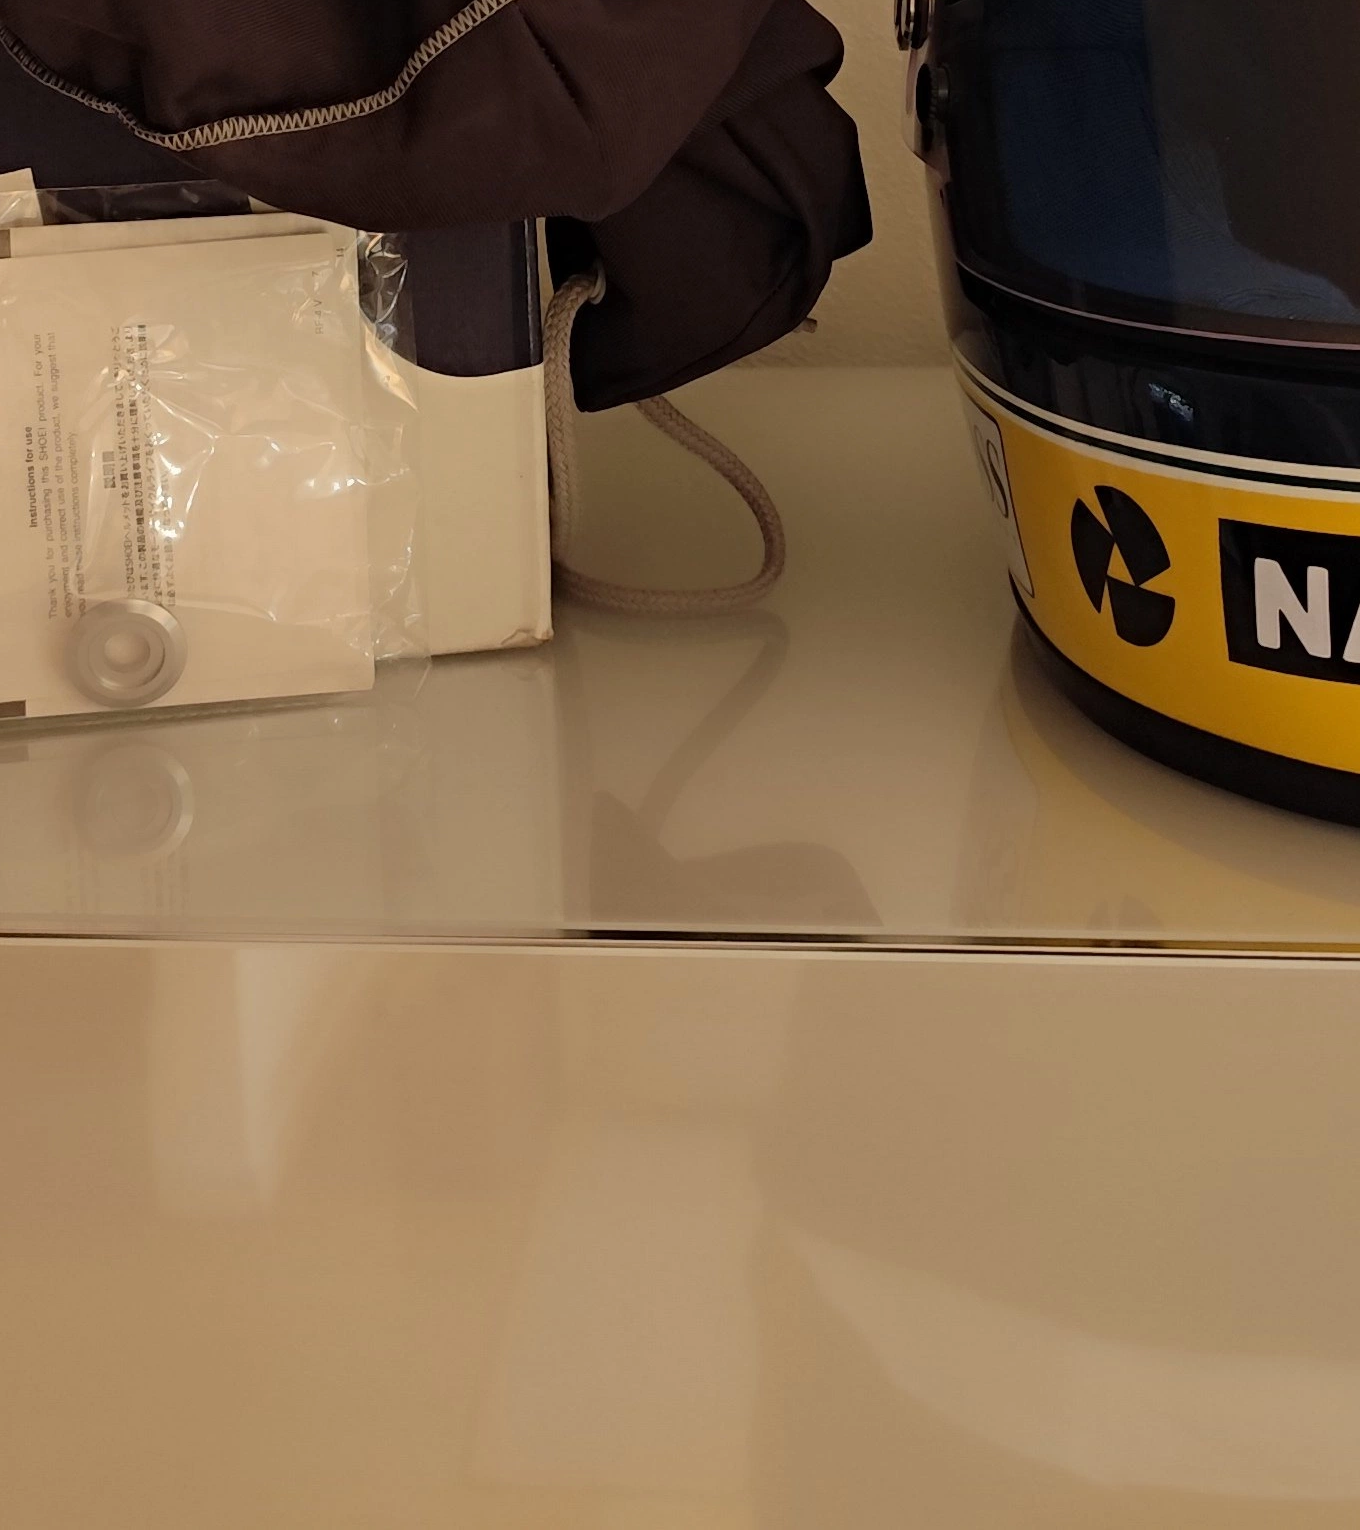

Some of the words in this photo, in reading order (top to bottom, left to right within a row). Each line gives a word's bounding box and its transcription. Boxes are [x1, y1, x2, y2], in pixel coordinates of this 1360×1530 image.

[33, 333, 44, 356] your
[47, 332, 56, 351] that
[33, 361, 43, 377] For
[48, 354, 60, 391] suggest
[51, 395, 60, 410] we
[25, 426, 33, 445] use
[37, 427, 49, 461] SHOEI
[25, 448, 34, 462] for
[54, 455, 63, 471] the
[41, 465, 49, 483] this
[55, 474, 64, 484] of
[26, 465, 38, 528] Instructions
[57, 487, 66, 505] use
[43, 488, 55, 541] purchasing
[71, 486, 81, 542] instructions
[58, 508, 67, 542] correct
[45, 547, 54, 560] for
[60, 544, 69, 563] and
[48, 564, 58, 583] you
[61, 567, 74, 619] enjoyment
[48, 588, 58, 619] Thank
